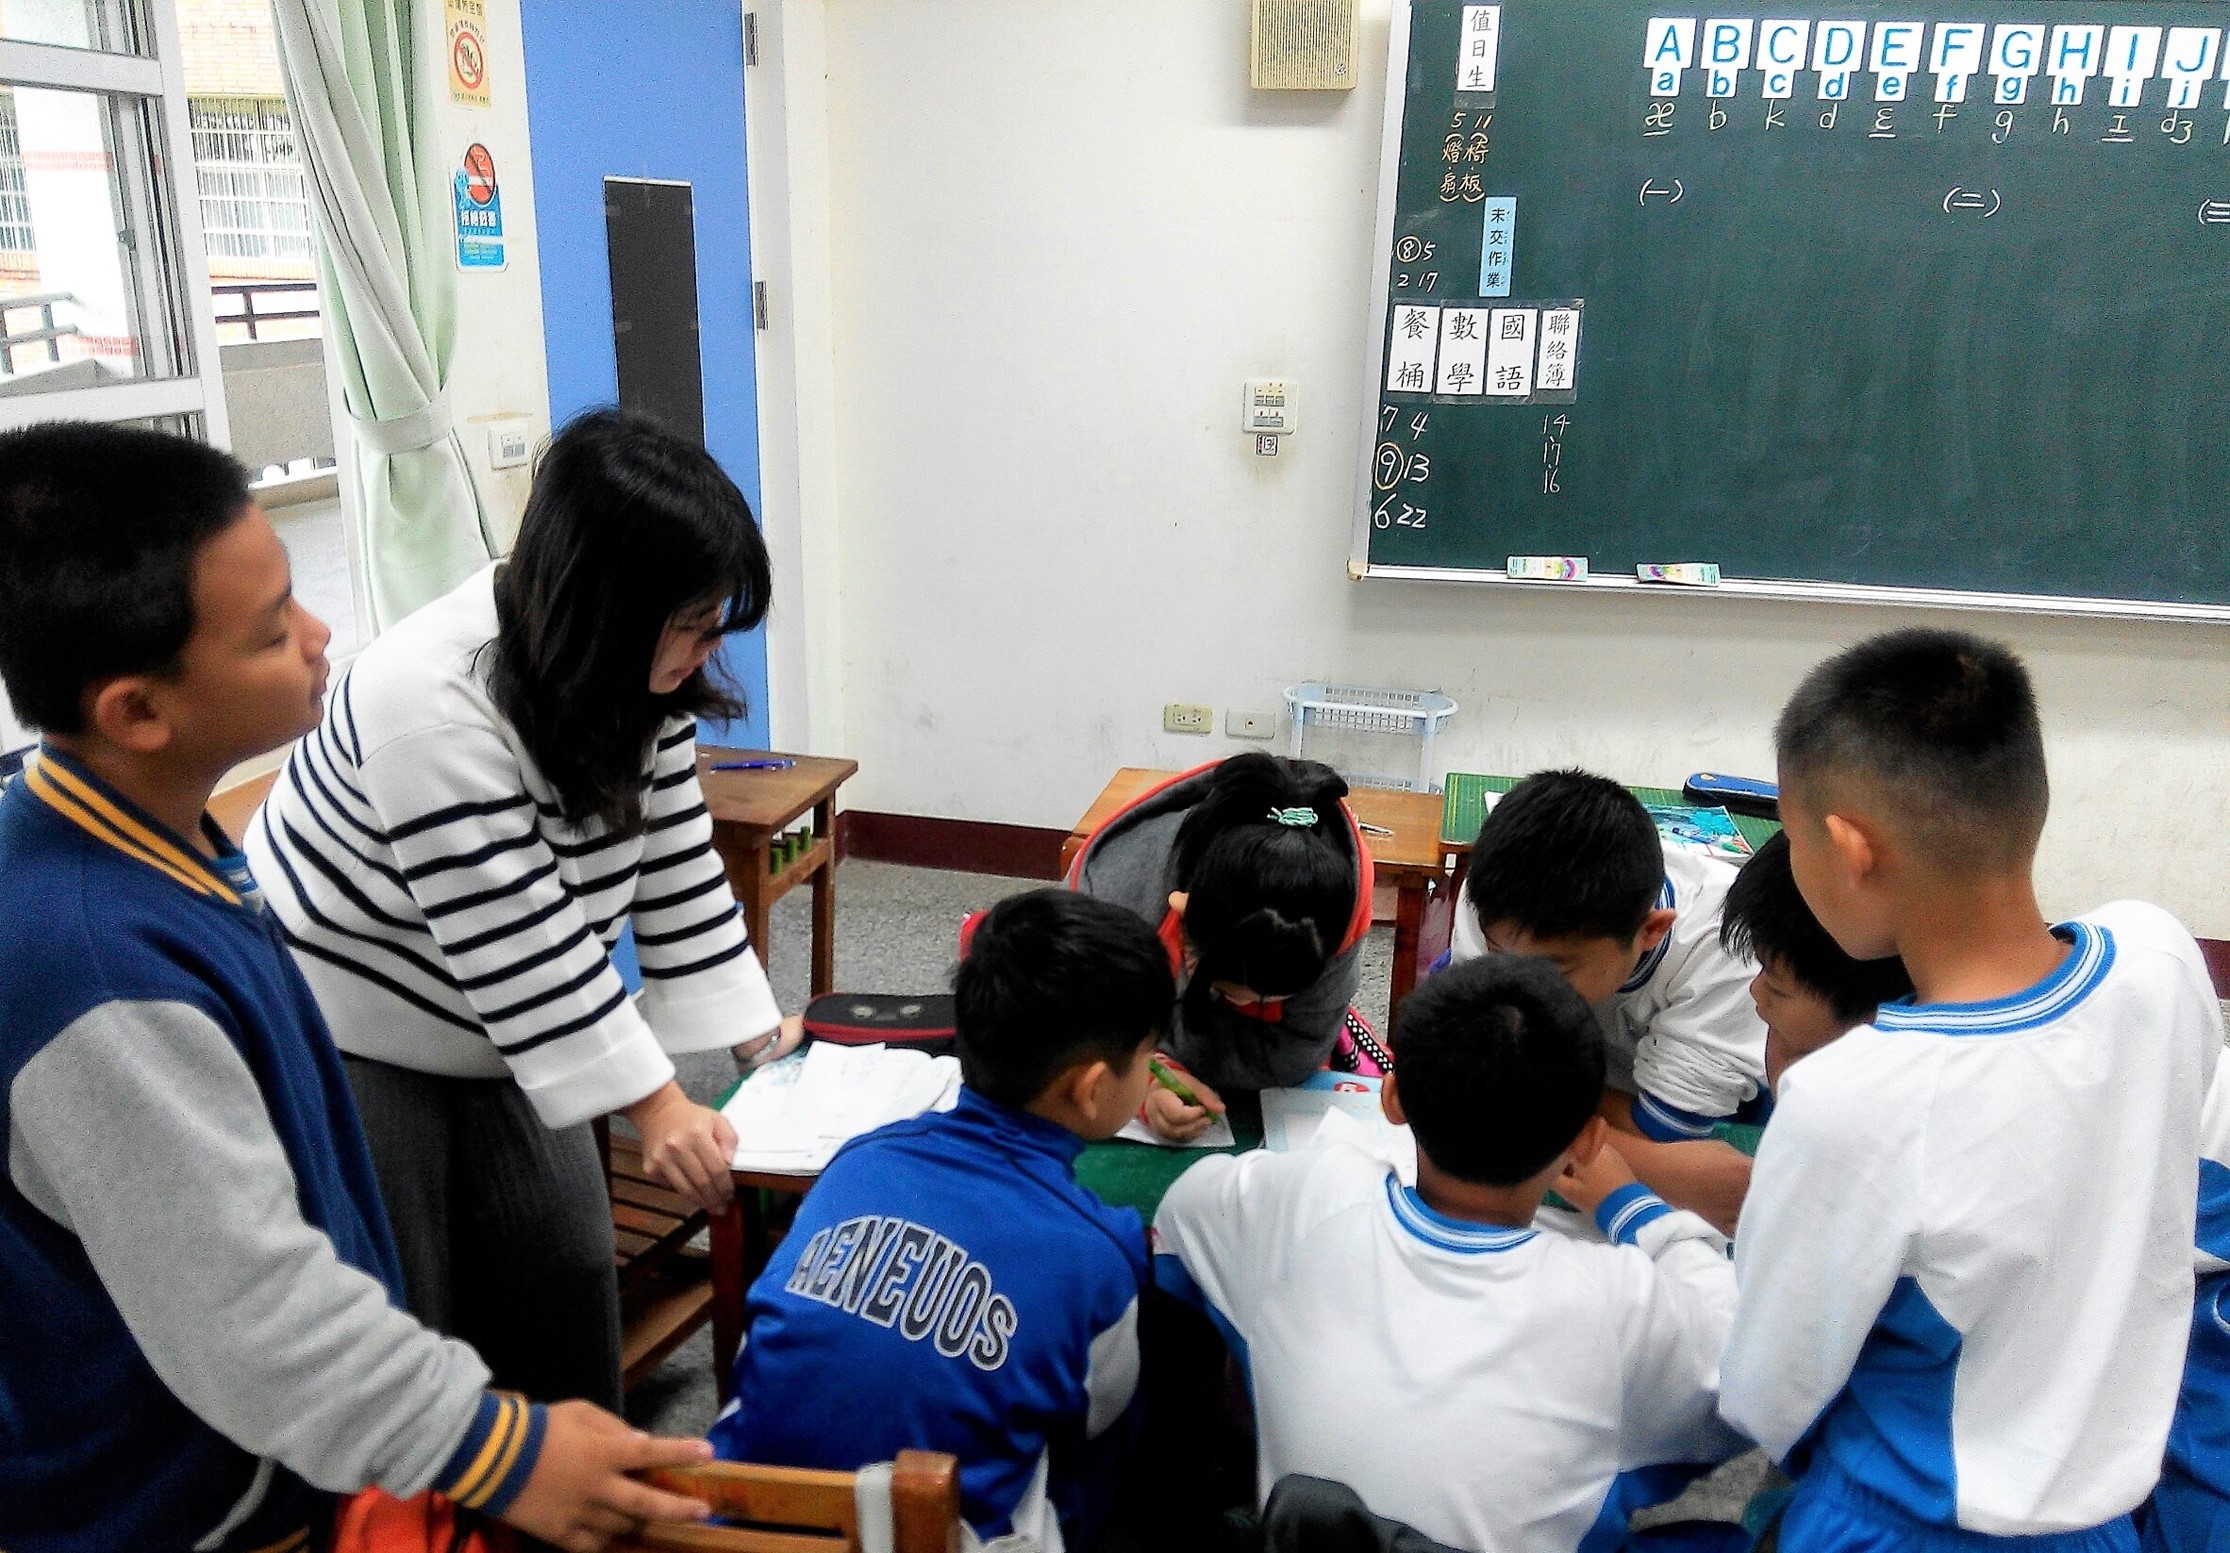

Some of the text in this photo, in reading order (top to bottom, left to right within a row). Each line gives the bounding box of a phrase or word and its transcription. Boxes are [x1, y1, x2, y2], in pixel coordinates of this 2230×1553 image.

[1465, 9, 1492, 88] 值日生
[1655, 25, 1681, 61] A
[1712, 25, 1741, 63] B
[1769, 26, 1797, 63] C
[1823, 28, 1853, 65] D
[1881, 28, 1912, 66] E
[1941, 29, 1972, 66] F
[2002, 31, 2032, 68] G
[2058, 31, 2091, 69] H
[2176, 36, 2209, 72] J
[1657, 70, 2189, 106] a b c d e f g h i j
[1451, 112, 1493, 129] 5 11
[1423, 241, 1436, 260] 5
[1486, 208, 1506, 288] 未交作業
[1397, 272, 1439, 293] 2 17
[1396, 308, 1430, 390] 餐桶
[1447, 312, 1479, 393] 數學
[1495, 314, 1525, 391] 國語
[1545, 314, 1570, 387] 聯絡簿
[1382, 404, 1430, 441] 7 4
[1403, 453, 1431, 482] 13
[1374, 493, 1428, 529] 6 22
[783, 1214, 1019, 1371] AENEUOS
